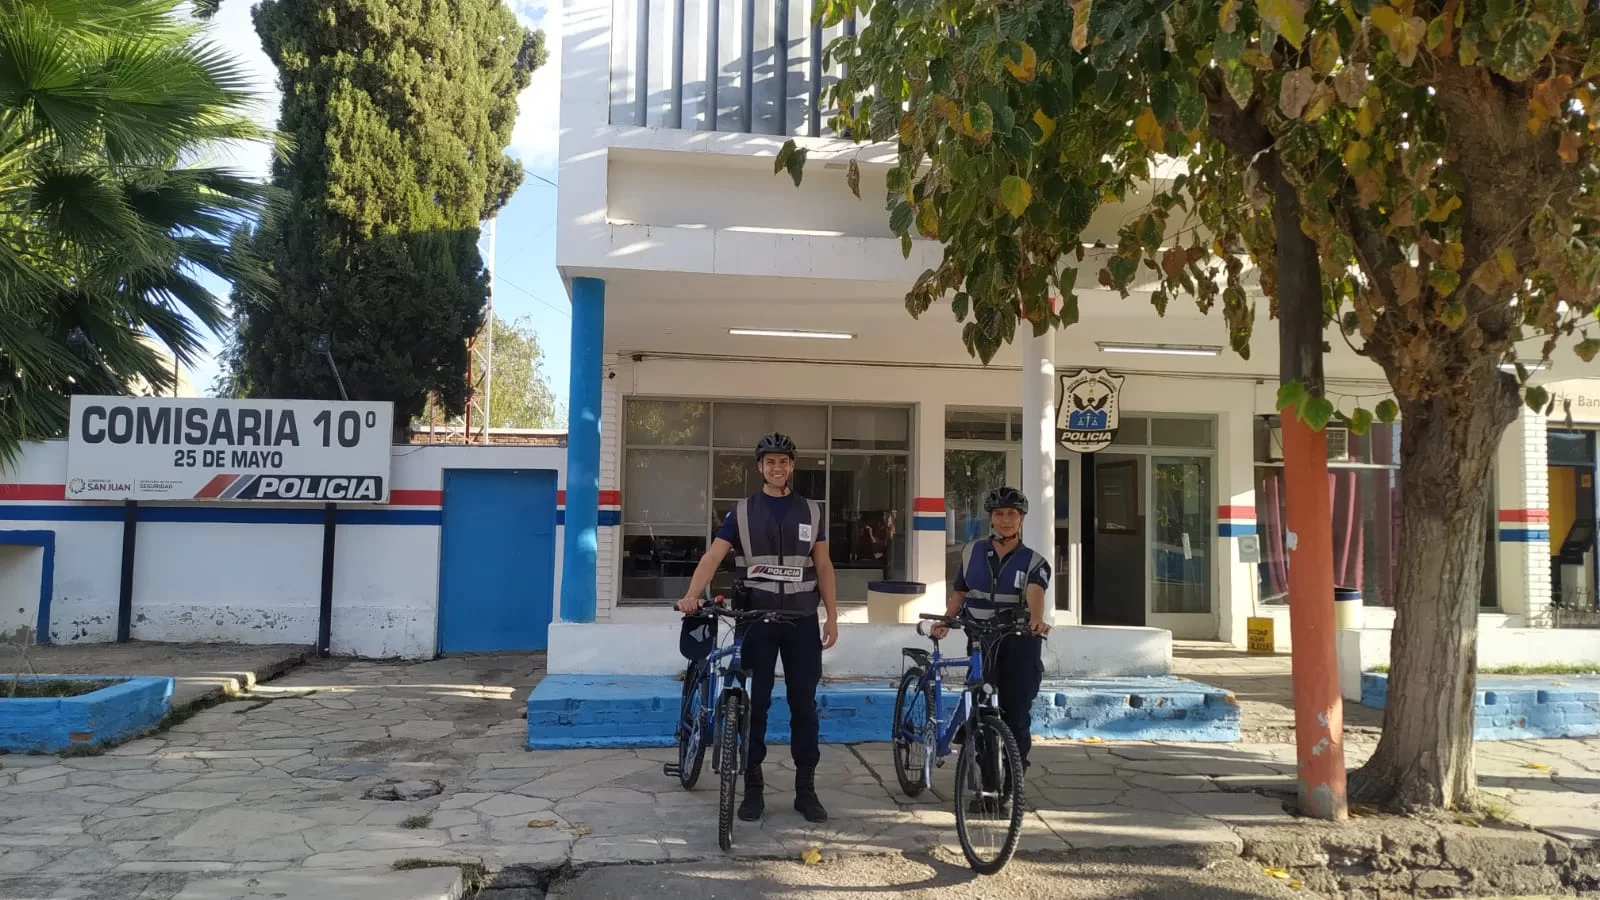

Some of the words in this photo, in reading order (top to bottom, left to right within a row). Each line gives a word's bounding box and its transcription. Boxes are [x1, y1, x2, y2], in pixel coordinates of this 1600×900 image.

[82, 406, 299, 446] COMISARIA
[1062, 432, 1111, 440] POLICIA
[174, 450, 197, 467] 25
[202, 450, 226, 468] DE
[231, 450, 283, 468] MAYO
[87, 483, 105, 491] SAN
[256, 477, 377, 499] POLICIA
[767, 568, 800, 576] POLICIA
